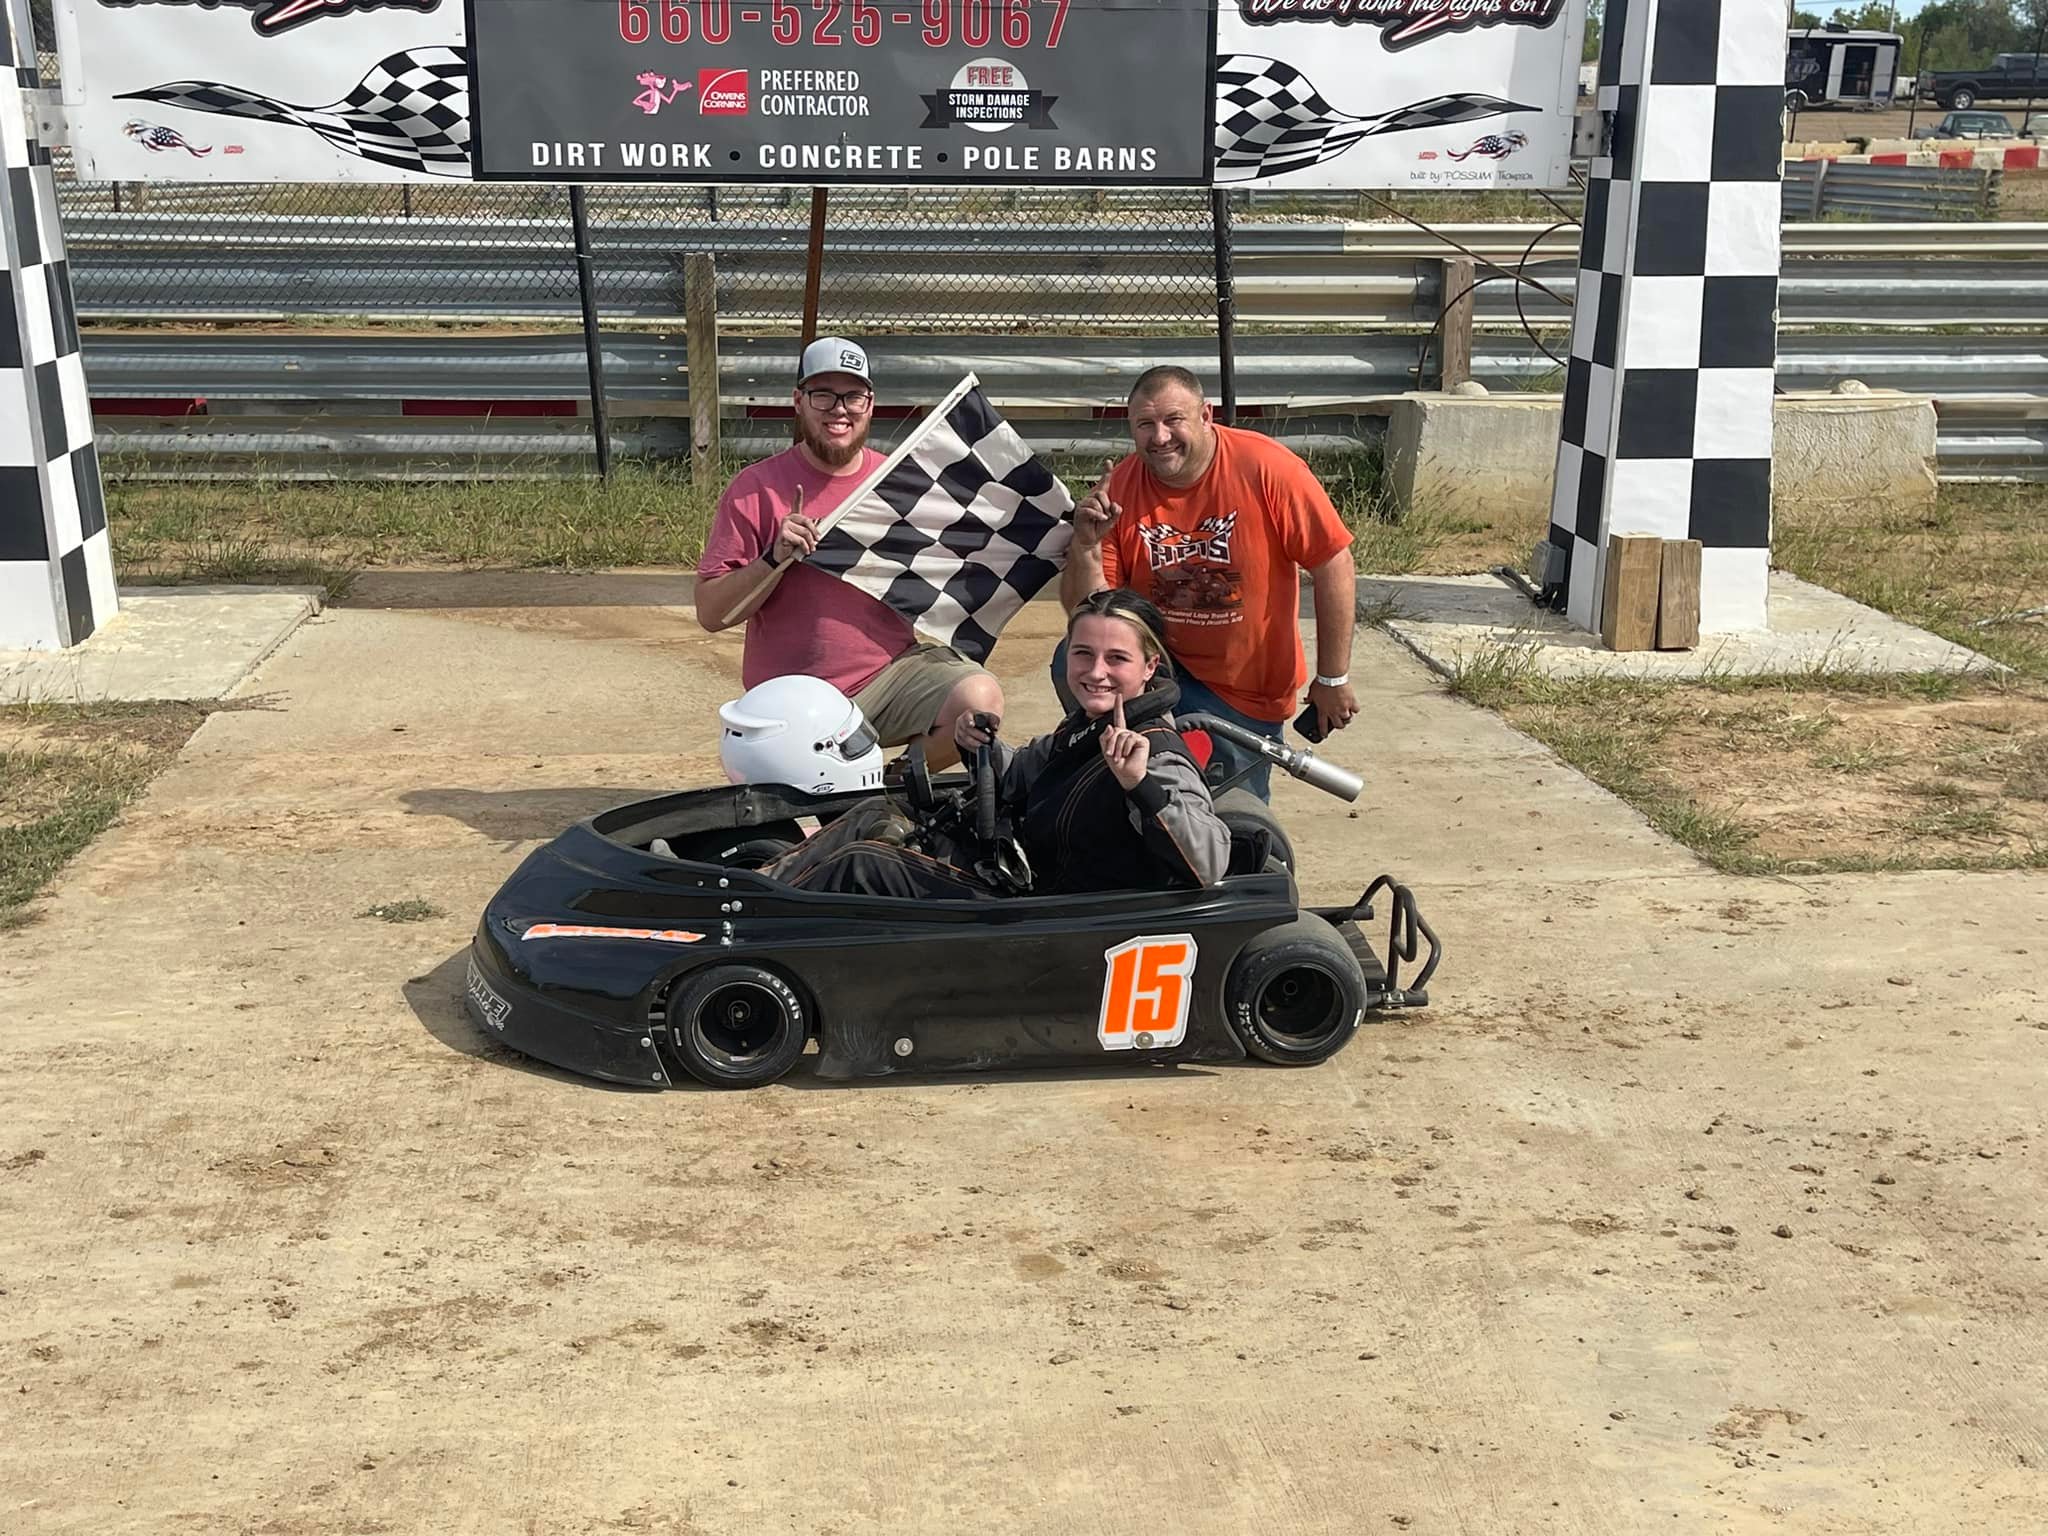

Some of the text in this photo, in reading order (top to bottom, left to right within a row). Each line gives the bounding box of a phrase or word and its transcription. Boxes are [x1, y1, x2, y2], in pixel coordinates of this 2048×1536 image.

[618, 0, 1070, 49] 660-525-9067
[760, 69, 860, 92] PREFERRED
[966, 66, 1014, 87] FREE
[703, 99, 747, 109] CORNING
[710, 91, 747, 100] OWENS
[760, 94, 871, 117] CONTRACTOR
[948, 94, 1030, 106] STORM DAMAGE
[955, 106, 1024, 119] INSPECTIONS
[531, 142, 1158, 171] DIRT WORK CONCRETE POLE BARNS
[1429, 171, 1441, 184] by
[1103, 941, 1190, 1035] 15
